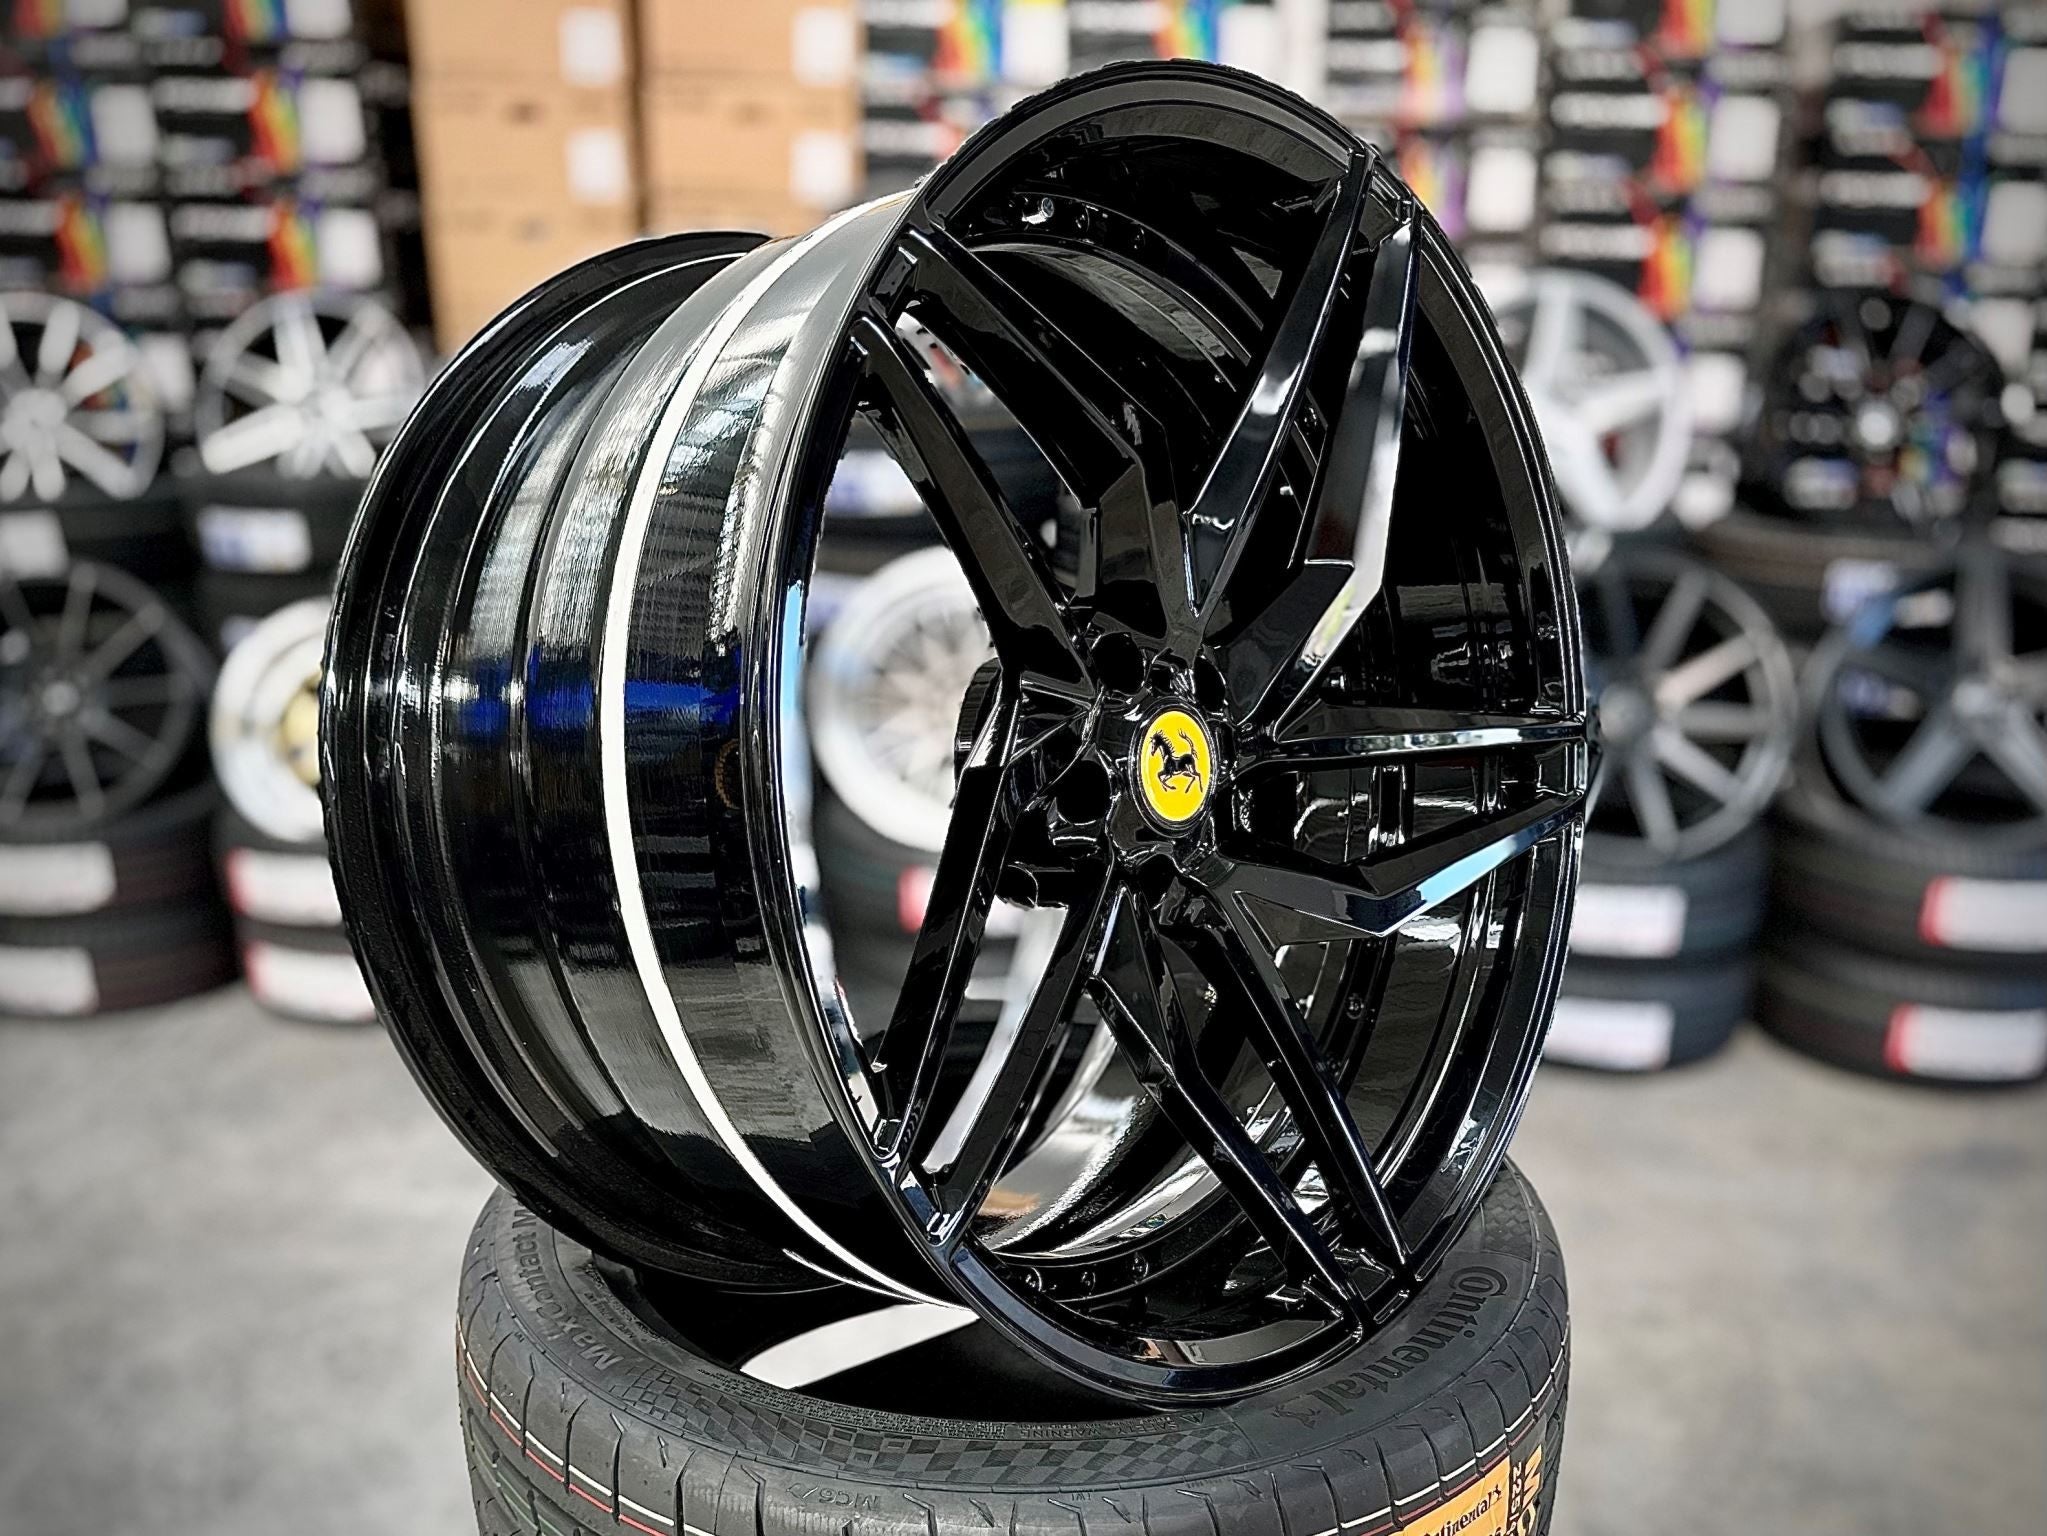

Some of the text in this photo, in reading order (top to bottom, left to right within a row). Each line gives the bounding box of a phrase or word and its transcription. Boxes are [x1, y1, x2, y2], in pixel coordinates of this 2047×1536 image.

[512, 1231, 625, 1371] MaxContact
[1306, 1266, 1508, 1415] Continental
[1019, 1427, 1101, 1439] WARNING
[1115, 1420, 1180, 1437] SAFETY
